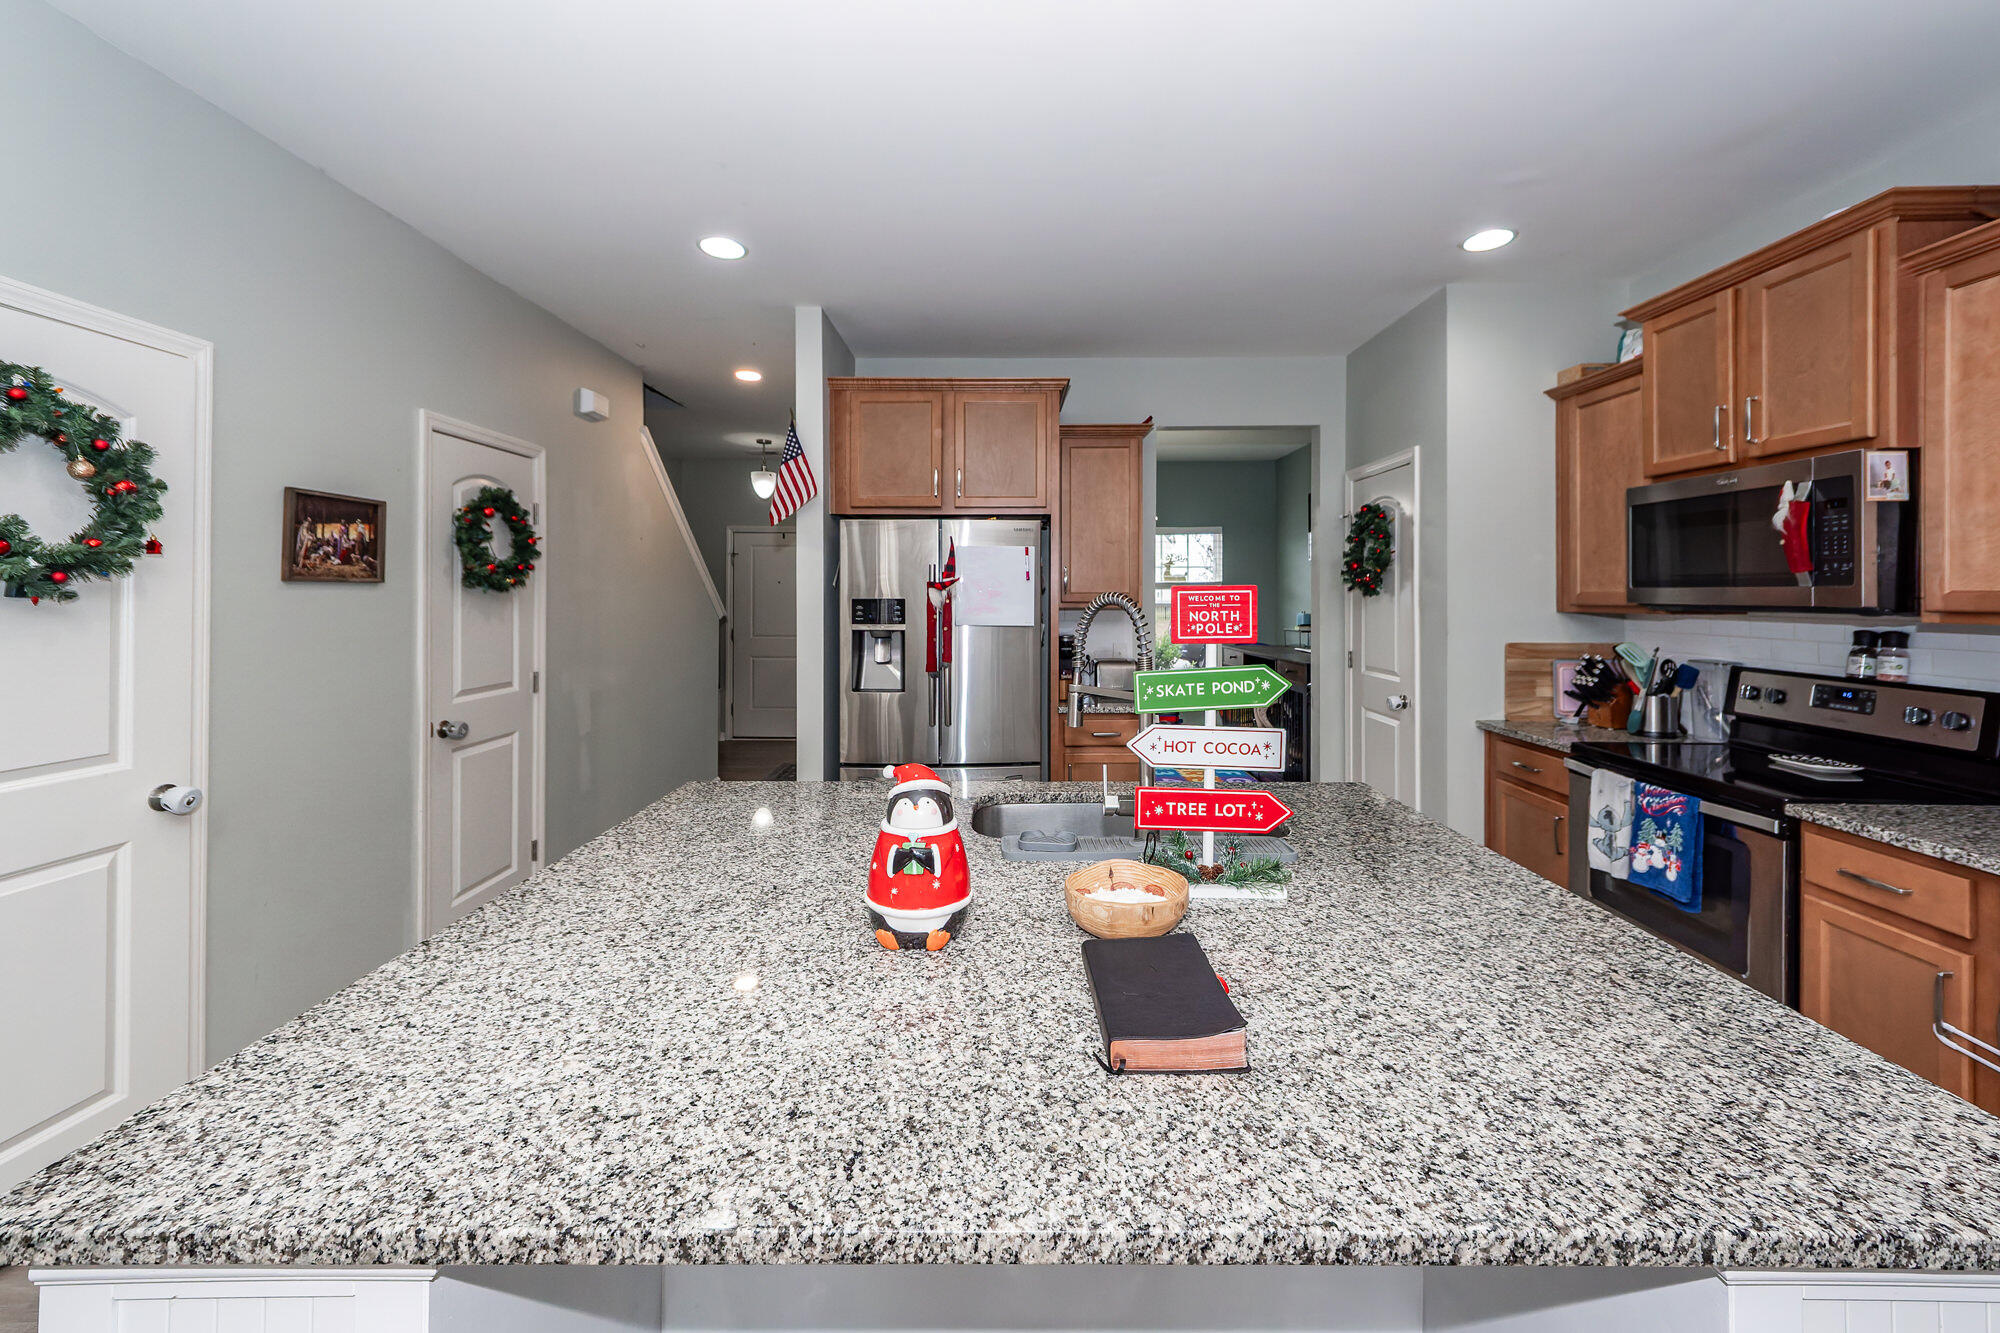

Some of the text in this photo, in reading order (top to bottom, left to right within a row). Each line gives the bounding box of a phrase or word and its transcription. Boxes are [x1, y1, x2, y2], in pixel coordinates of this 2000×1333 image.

[1189, 611, 1240, 622] NORTH
[1196, 623, 1233, 634] POLE
[1156, 680, 1255, 698] SKATE POND
[1164, 740, 1261, 756] HOT COCOA
[1165, 802, 1246, 817] TREE LOT
